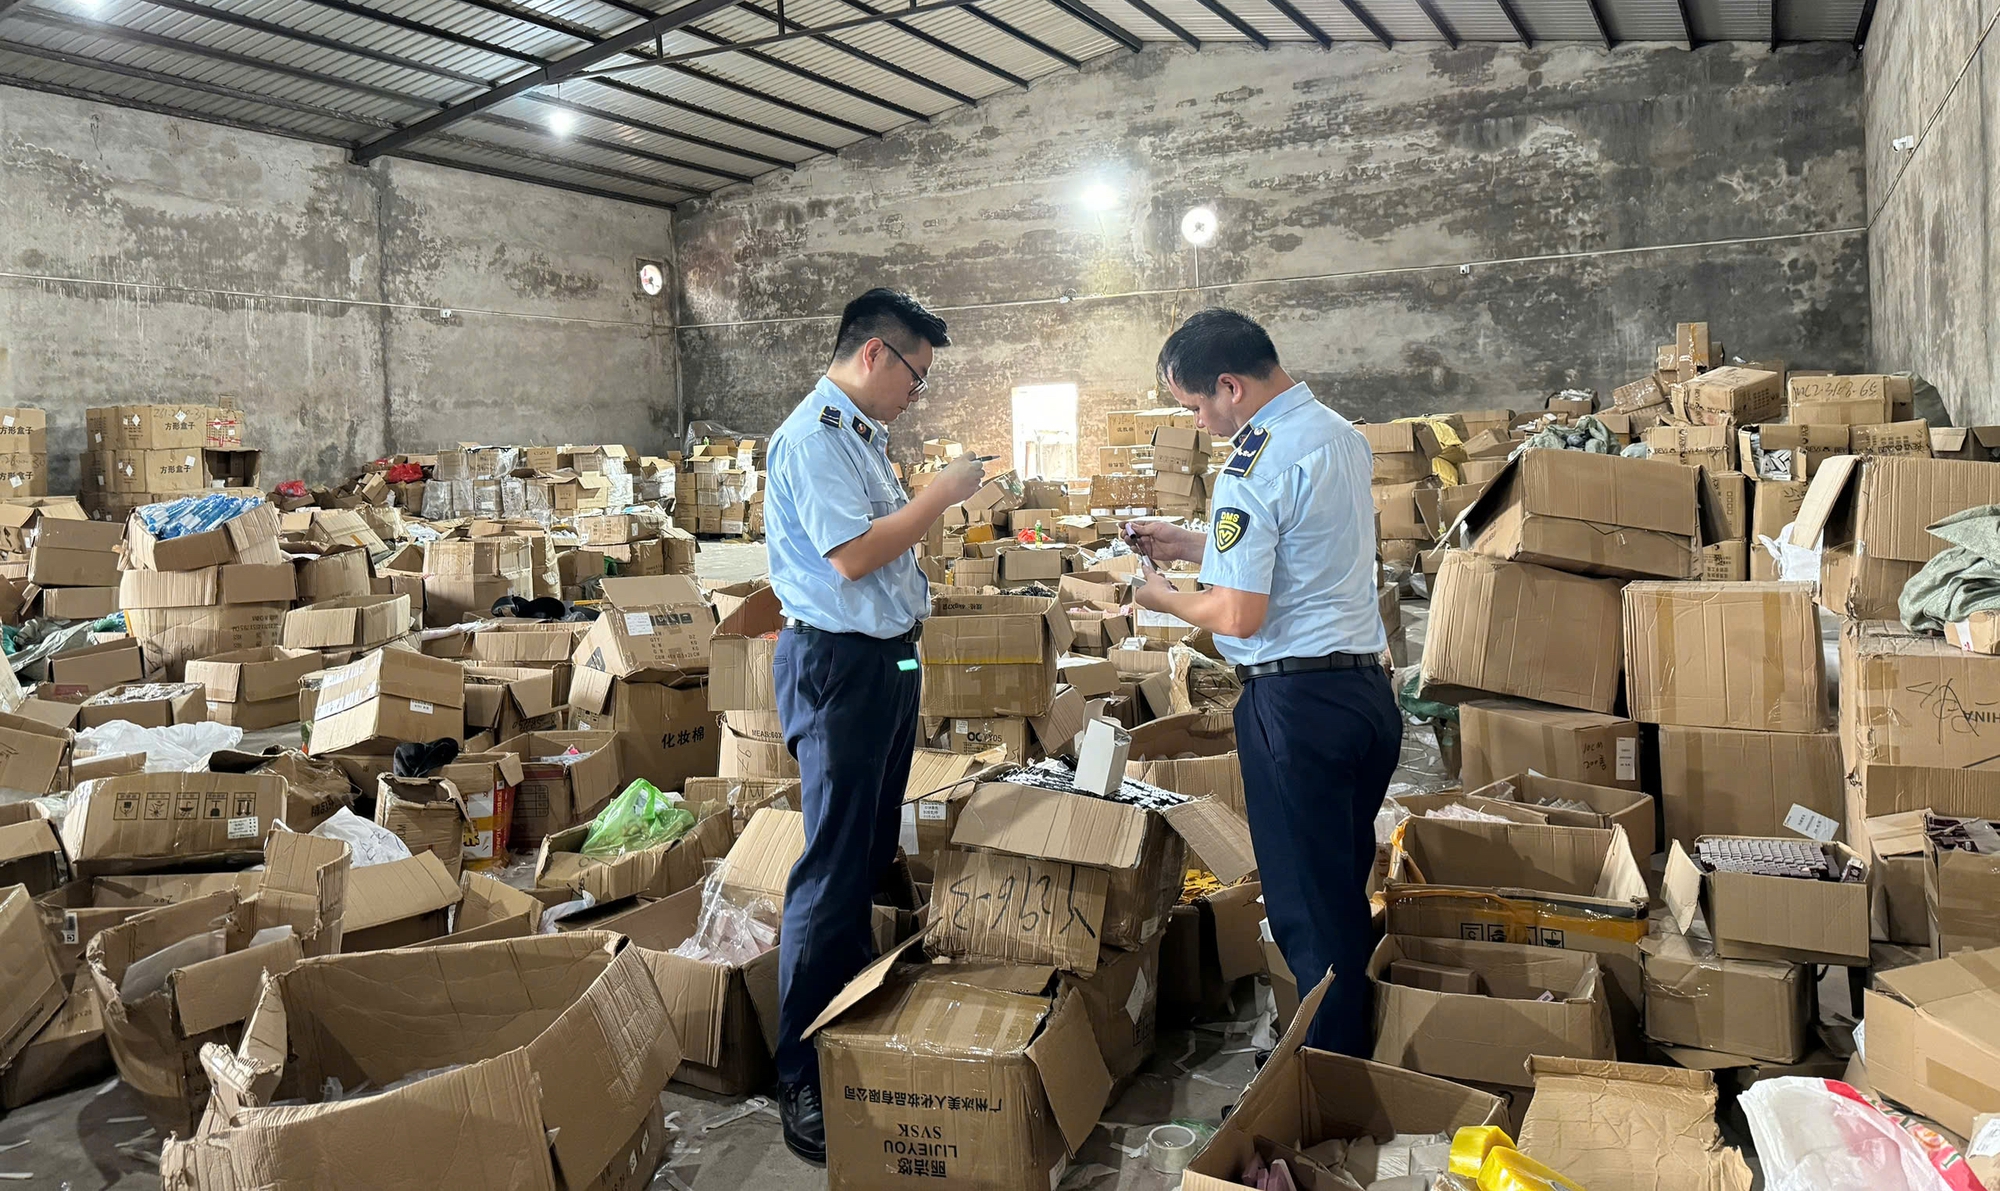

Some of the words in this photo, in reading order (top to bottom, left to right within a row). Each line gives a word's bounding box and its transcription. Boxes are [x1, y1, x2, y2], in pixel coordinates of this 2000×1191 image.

[0, 426, 33, 435] 方形盒子
[165, 421, 195, 431] 方形盒子
[160, 465, 191, 474] 方形盒子
[1221, 511, 1240, 523] DMS
[661, 726, 705, 749] 化妆棉
[844, 1085, 1002, 1113] 广州冰美人化妆品有限公司
[897, 1123, 942, 1139] SVSK
[883, 1140, 958, 1158] LIJIEYOU
[897, 1158, 947, 1178] 丽洁悠
